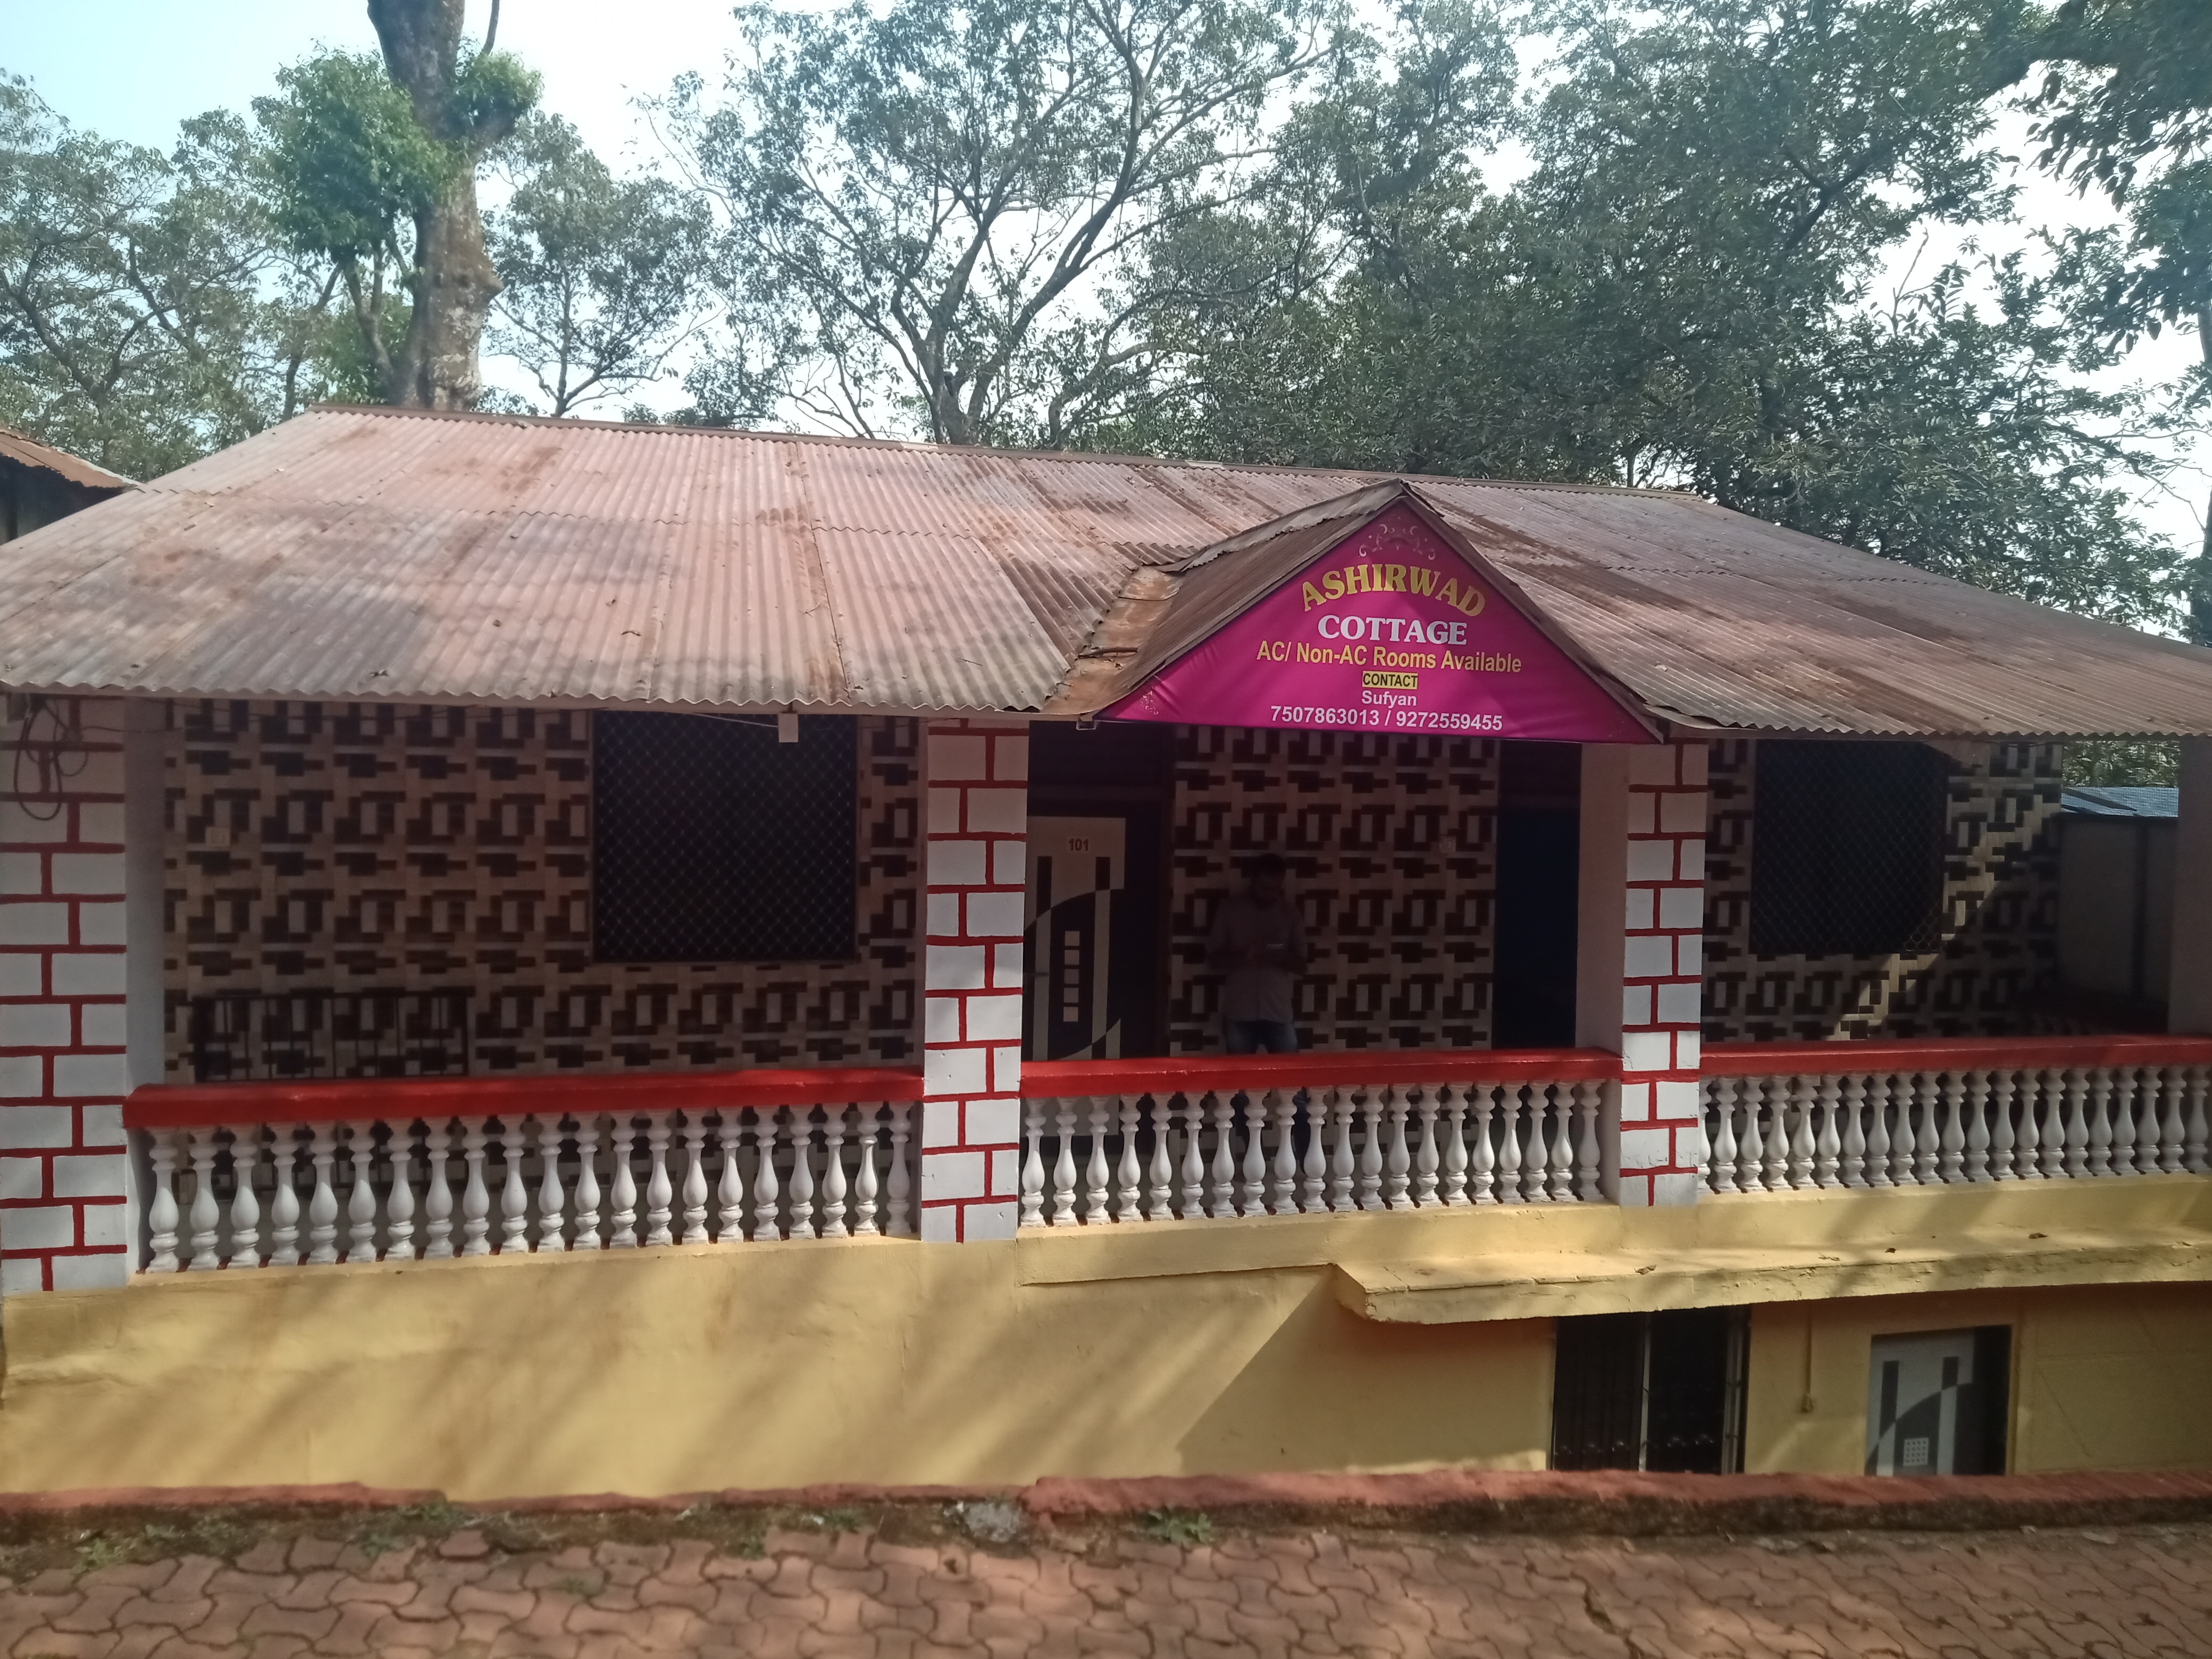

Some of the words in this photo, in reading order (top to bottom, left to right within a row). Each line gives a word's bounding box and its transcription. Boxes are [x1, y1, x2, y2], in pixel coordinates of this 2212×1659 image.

[1303, 564, 1486, 617] ASHIRWAD
[1318, 615, 1468, 645] COTTAGE
[1256, 640, 1291, 661] AC/
[1296, 643, 1367, 666] Non-AC
[1374, 647, 1436, 669] Rooms
[1441, 650, 1522, 673] Available
[1363, 672, 1418, 688] CONTACT
[1362, 690, 1417, 707] Sufyan
[1271, 706, 1380, 726] 7507863013
[1384, 710, 1391, 726] /
[1396, 711, 1503, 731] 9272559455
[1068, 837, 1090, 851] 101
